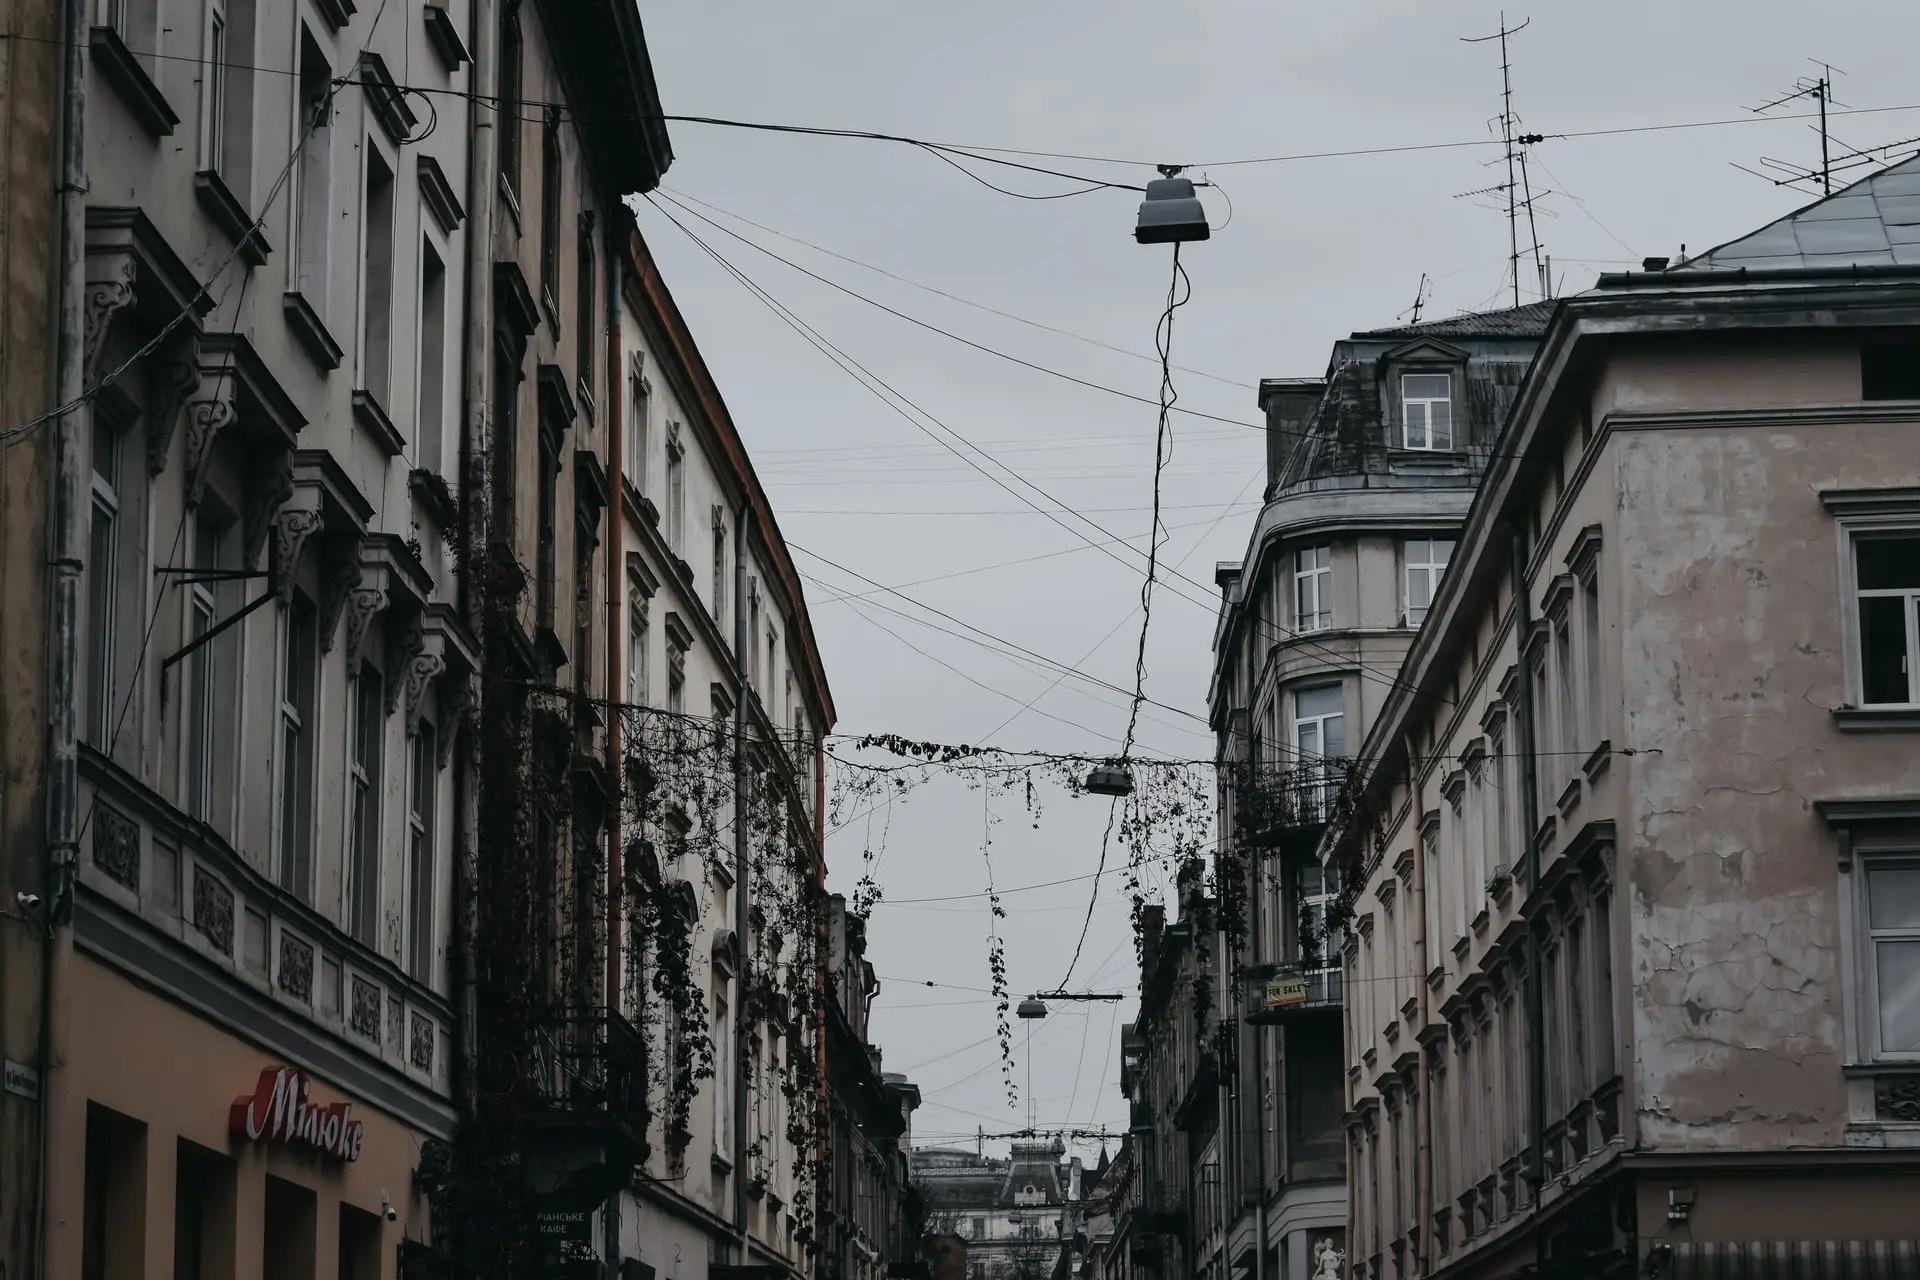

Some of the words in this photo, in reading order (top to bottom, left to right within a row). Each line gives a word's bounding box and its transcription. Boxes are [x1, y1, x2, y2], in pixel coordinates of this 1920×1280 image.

[1268, 986, 1281, 998] FOR
[1283, 983, 1303, 995] SALE
[539, 1224, 568, 1234] КАФЕ
